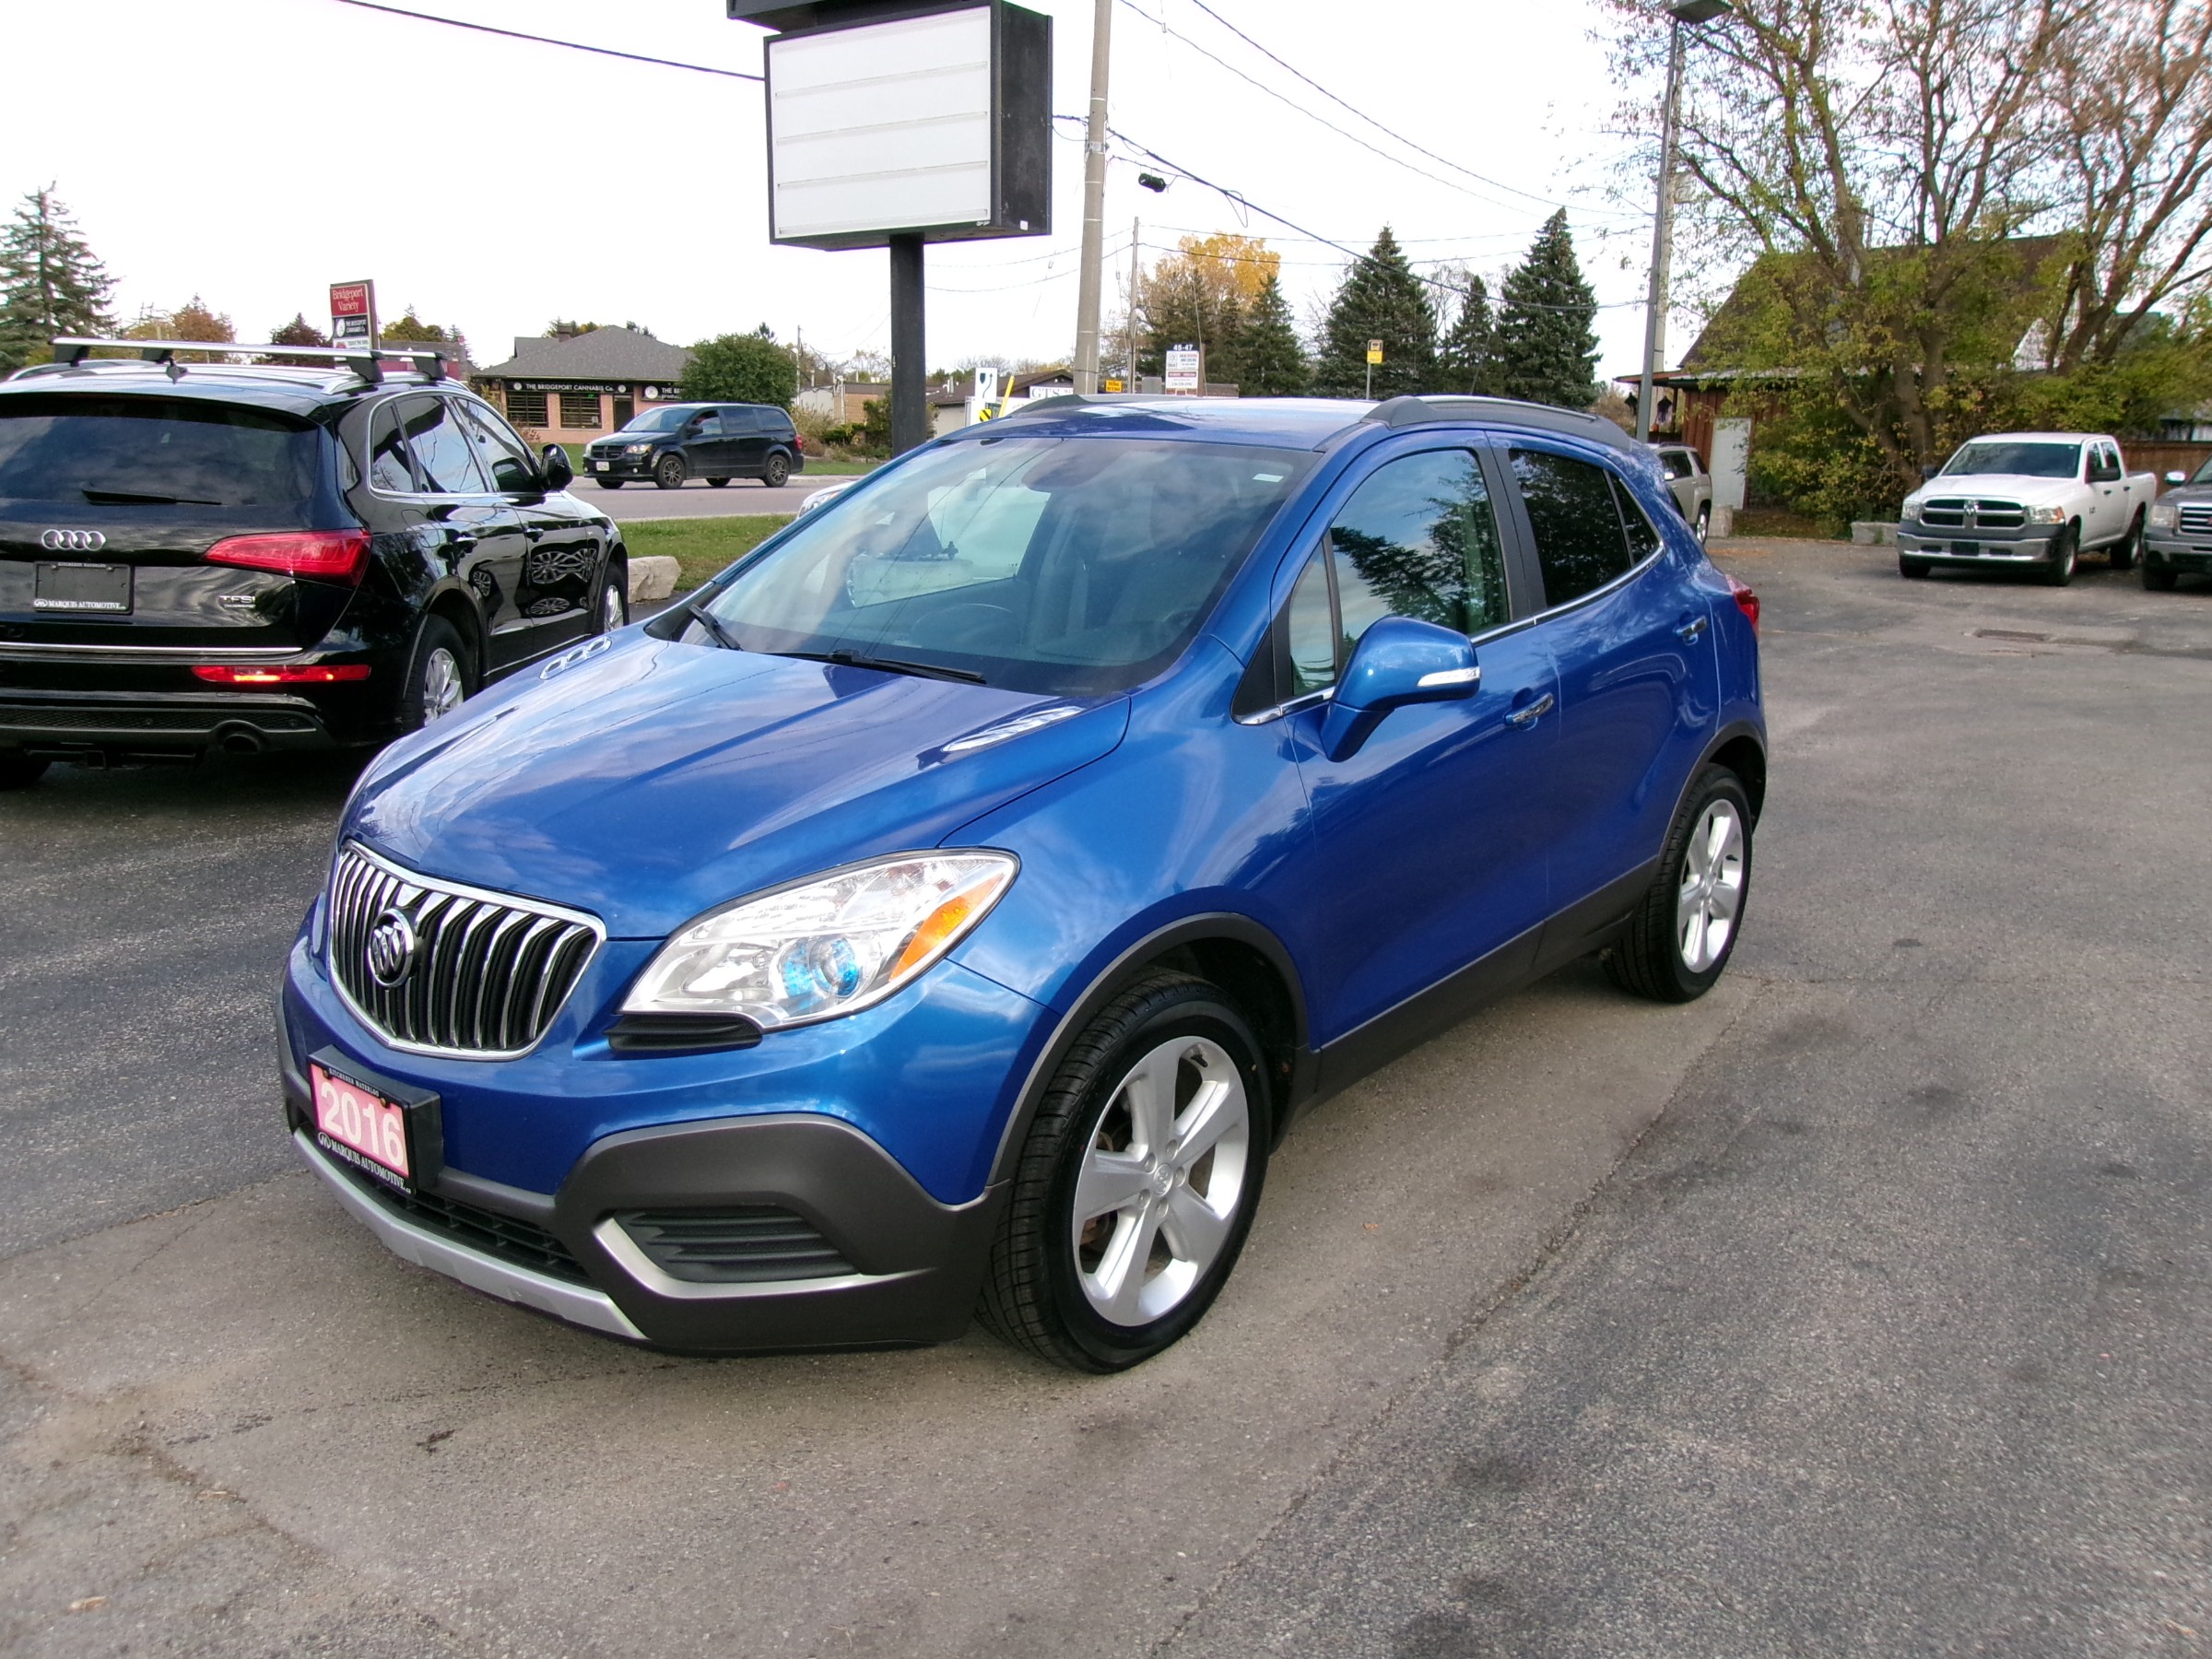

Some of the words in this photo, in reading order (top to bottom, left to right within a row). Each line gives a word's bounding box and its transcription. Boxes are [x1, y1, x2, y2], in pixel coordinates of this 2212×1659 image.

[333, 288, 363, 301] Bridgeport
[337, 301, 359, 312] Variety
[1031, 387, 1060, 398] GTS
[48, 600, 77, 608] MARQUIS
[219, 595, 256, 604] TFSI
[328, 1067, 355, 1085] KITCHENER
[355, 1079, 380, 1097] WATERLOO
[321, 1081, 404, 1167] 2016
[331, 1138, 361, 1165] MARQUIS
